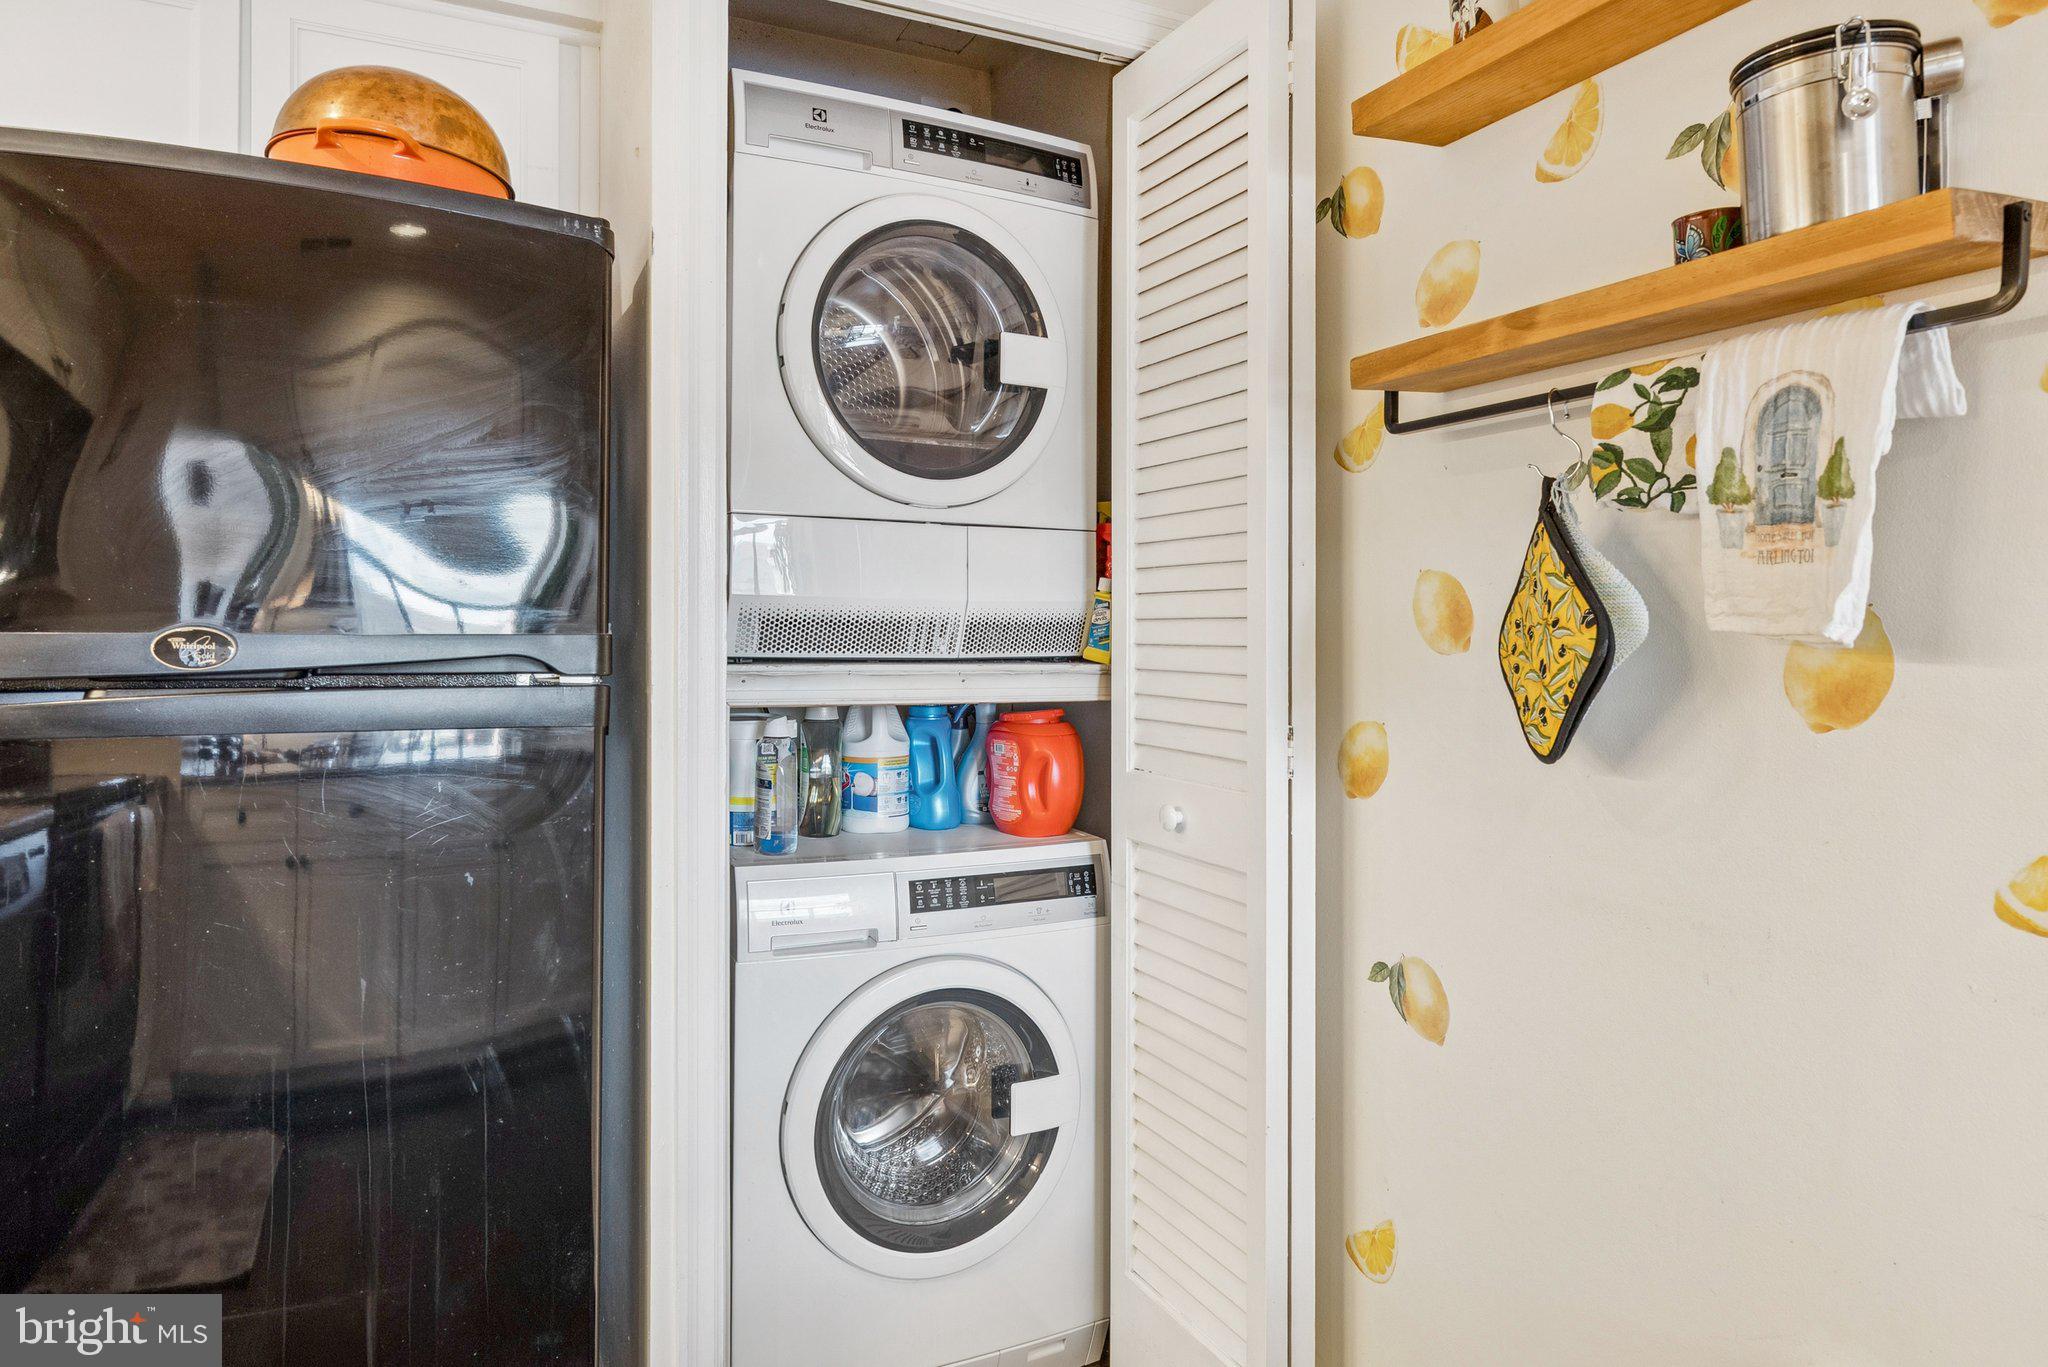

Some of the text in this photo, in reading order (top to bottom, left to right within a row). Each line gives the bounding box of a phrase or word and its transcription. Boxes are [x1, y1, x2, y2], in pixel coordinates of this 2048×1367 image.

[804, 122, 835, 133] Electrolux
[170, 639, 217, 652] Whirlpool
[771, 919, 804, 927] Electrolux
